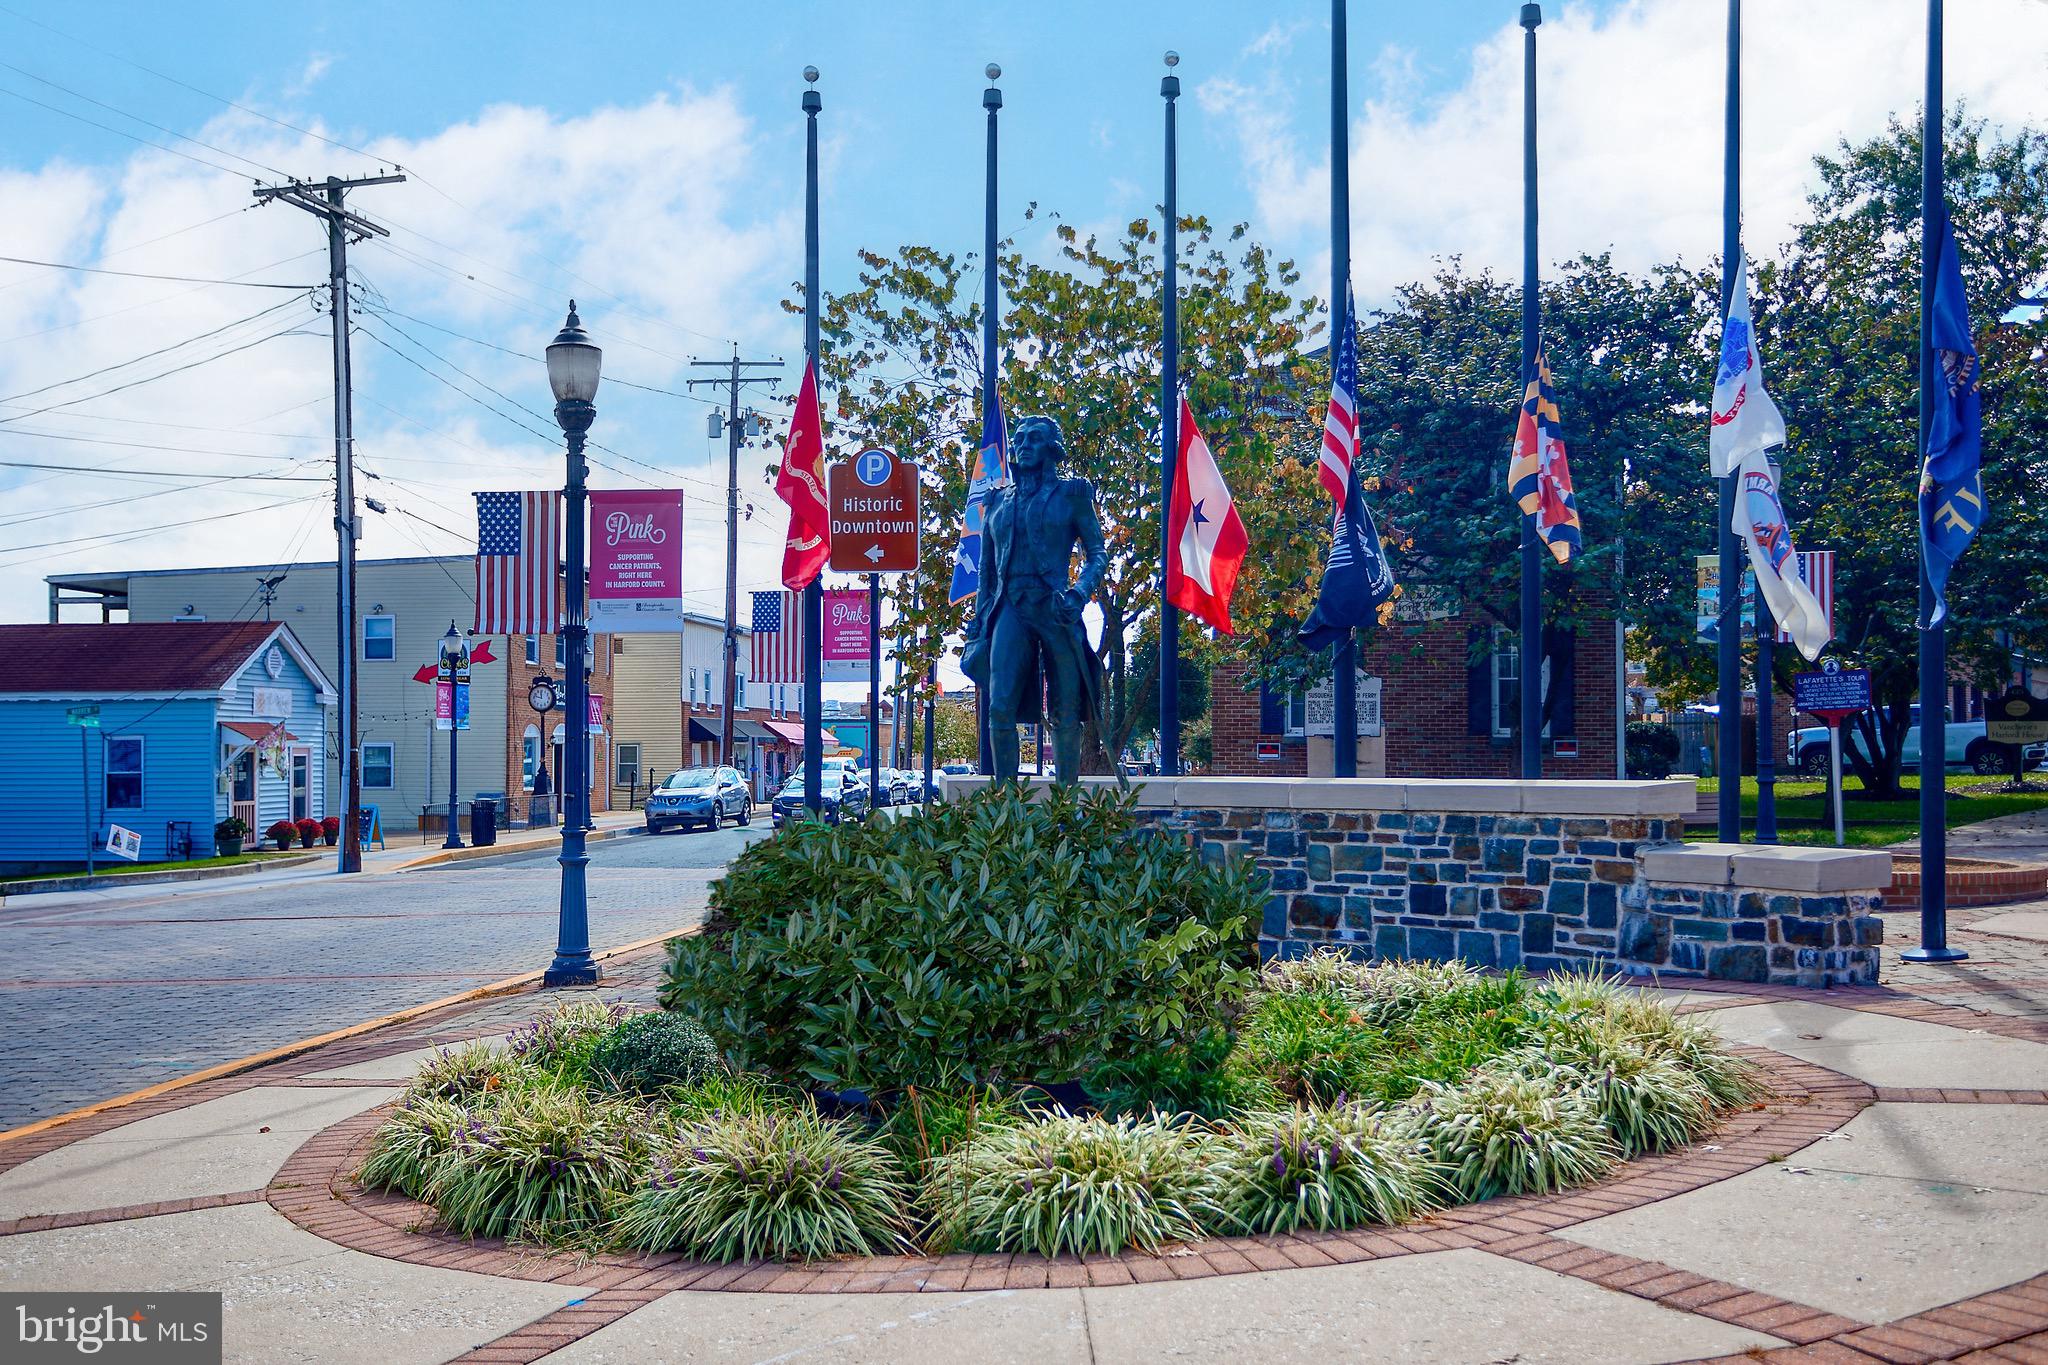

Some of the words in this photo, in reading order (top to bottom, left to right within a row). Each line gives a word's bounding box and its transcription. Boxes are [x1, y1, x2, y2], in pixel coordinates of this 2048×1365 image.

[866, 455, 885, 481] P
[799, 471, 817, 493] STATES
[843, 496, 903, 512] Historic
[605, 511, 666, 546] Pink
[832, 519, 914, 534] Downtown
[617, 553, 654, 561] SUPPORTING
[633, 562, 662, 570] PATIENTS,
[636, 571, 653, 579] HERE
[641, 580, 666, 588] COUNTY.
[832, 603, 871, 626] Pink
[1798, 676, 1844, 685] LAFAYETTE'S
